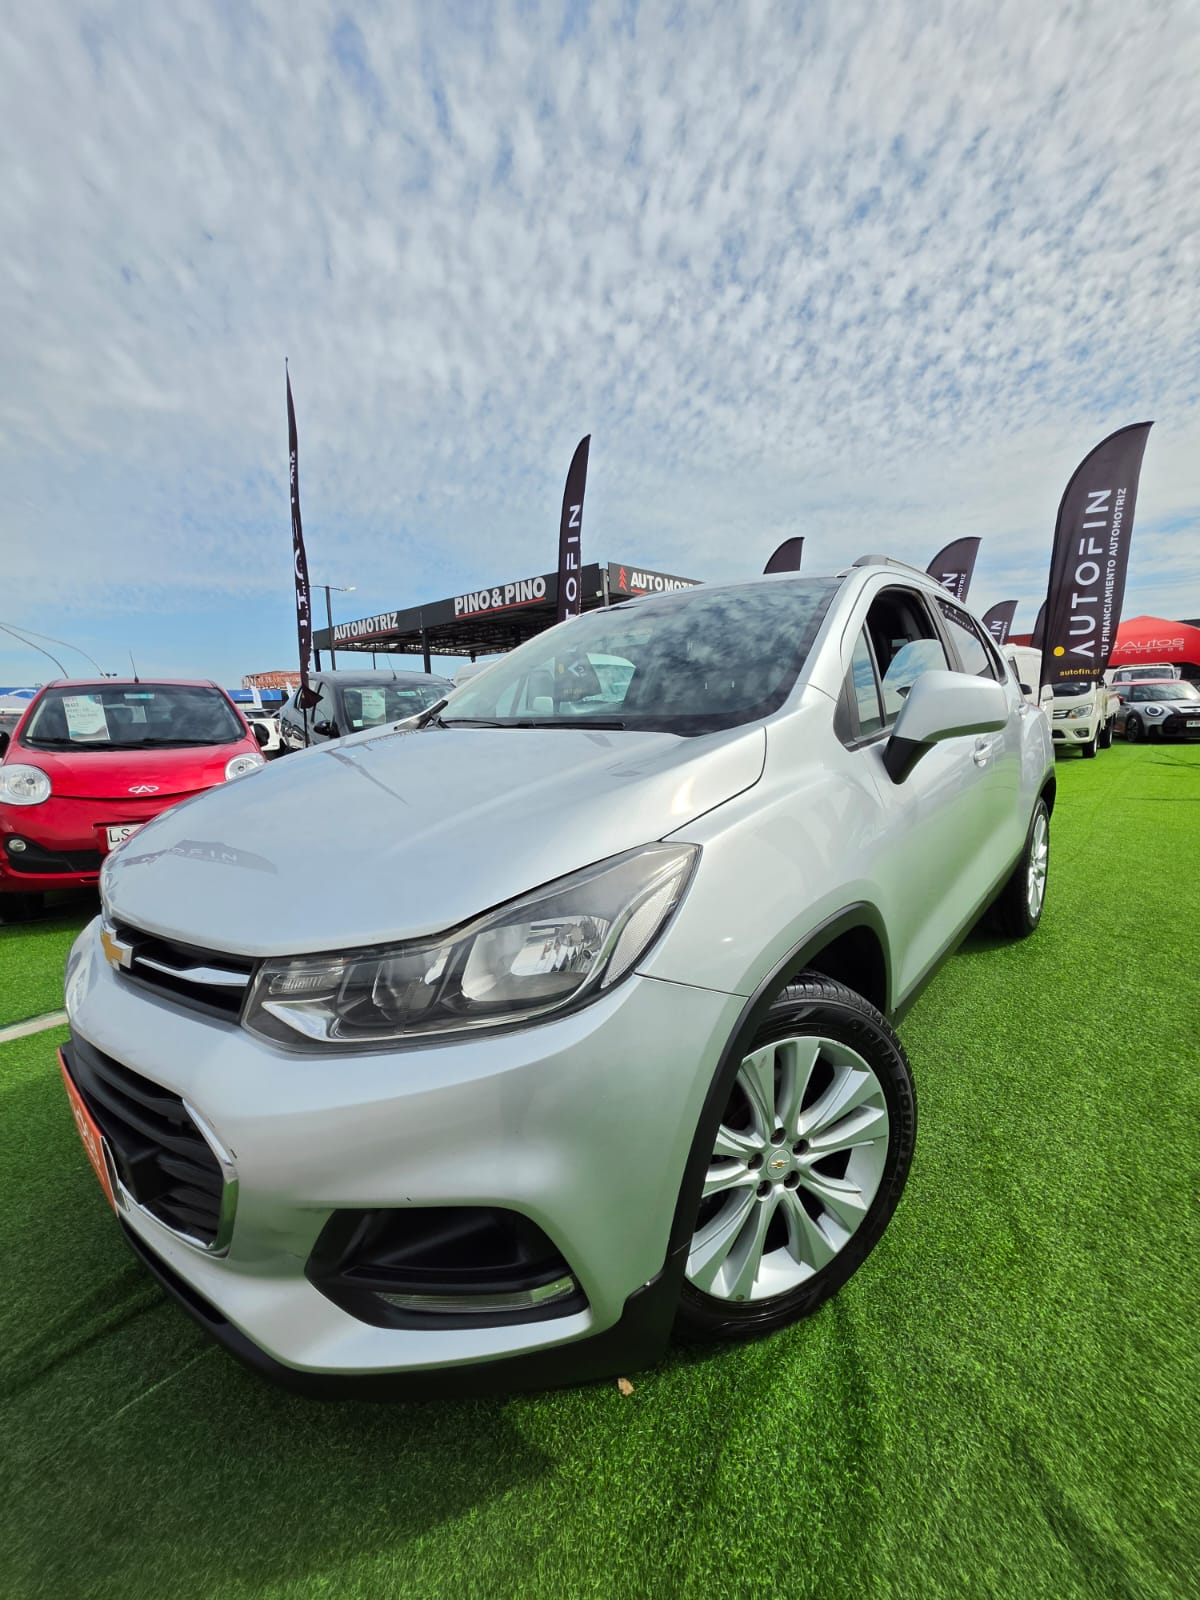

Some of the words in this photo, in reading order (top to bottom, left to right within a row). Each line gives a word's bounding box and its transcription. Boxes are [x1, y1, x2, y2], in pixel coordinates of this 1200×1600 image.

[1109, 487, 1127, 557] AUTOMOTRIZ
[1069, 489, 1112, 658] AUTOFIN
[1101, 559, 1117, 642] FINANCIAMIENTO
[334, 612, 399, 641] AUTOMOTRIZ
[1100, 643, 1110, 657] TU
